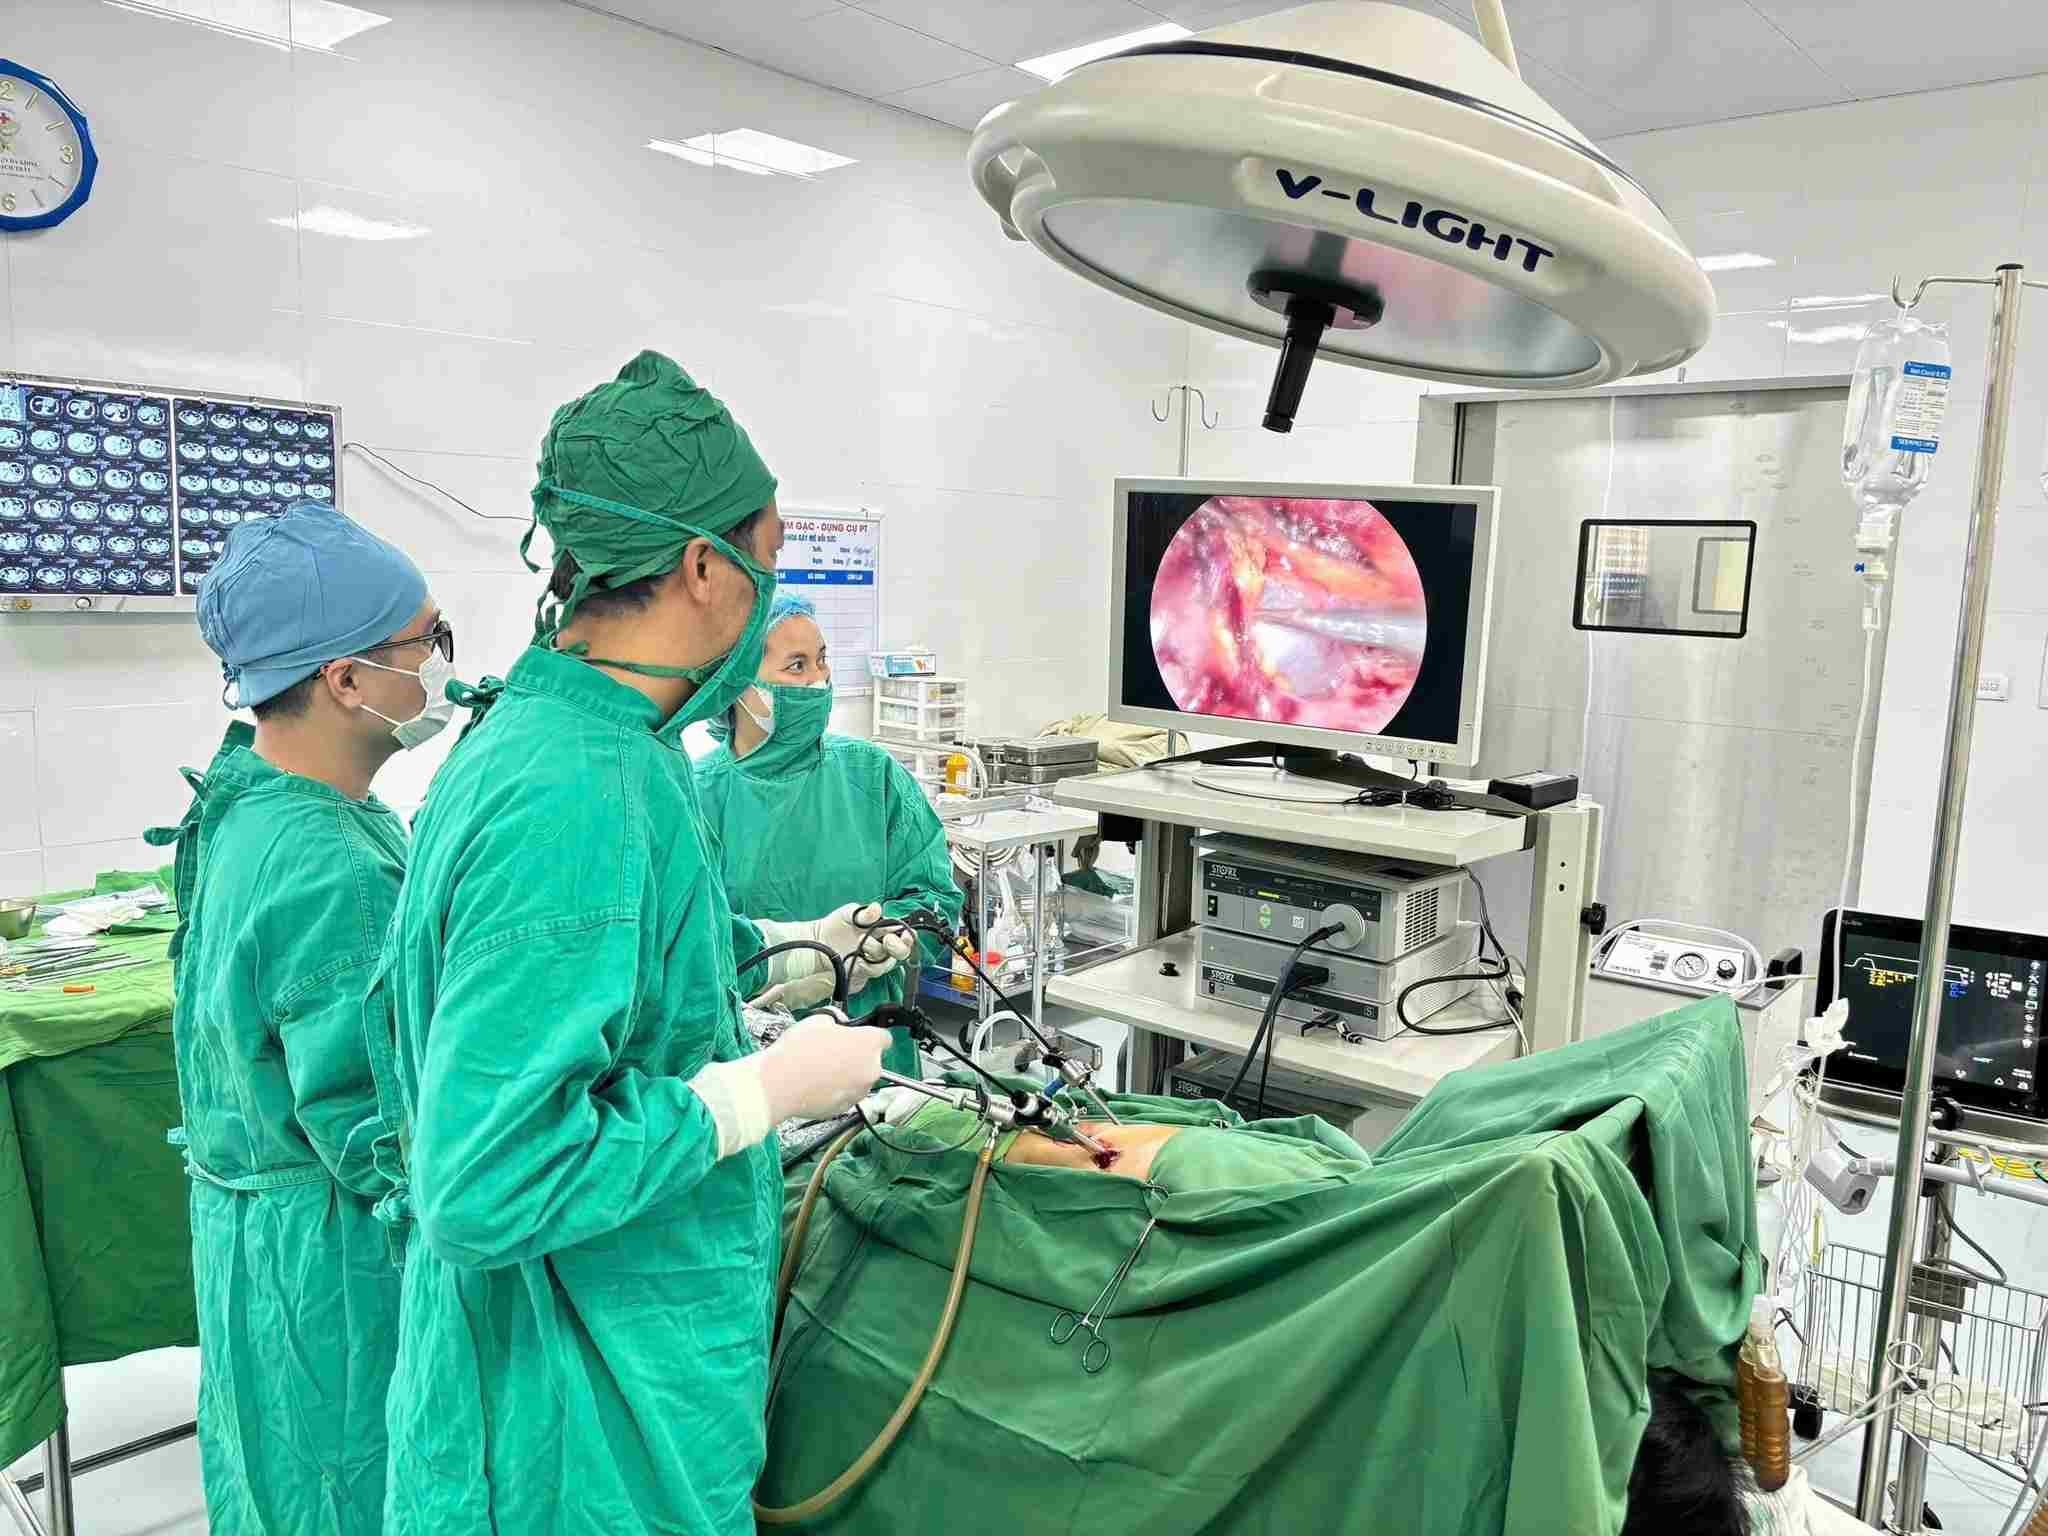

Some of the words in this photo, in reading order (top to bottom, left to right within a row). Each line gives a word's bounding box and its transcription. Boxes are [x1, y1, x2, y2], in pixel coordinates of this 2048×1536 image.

[60, 144, 73, 165] 3
[1, 193, 17, 212] 6
[1276, 168, 1554, 273] V-LIGHT
